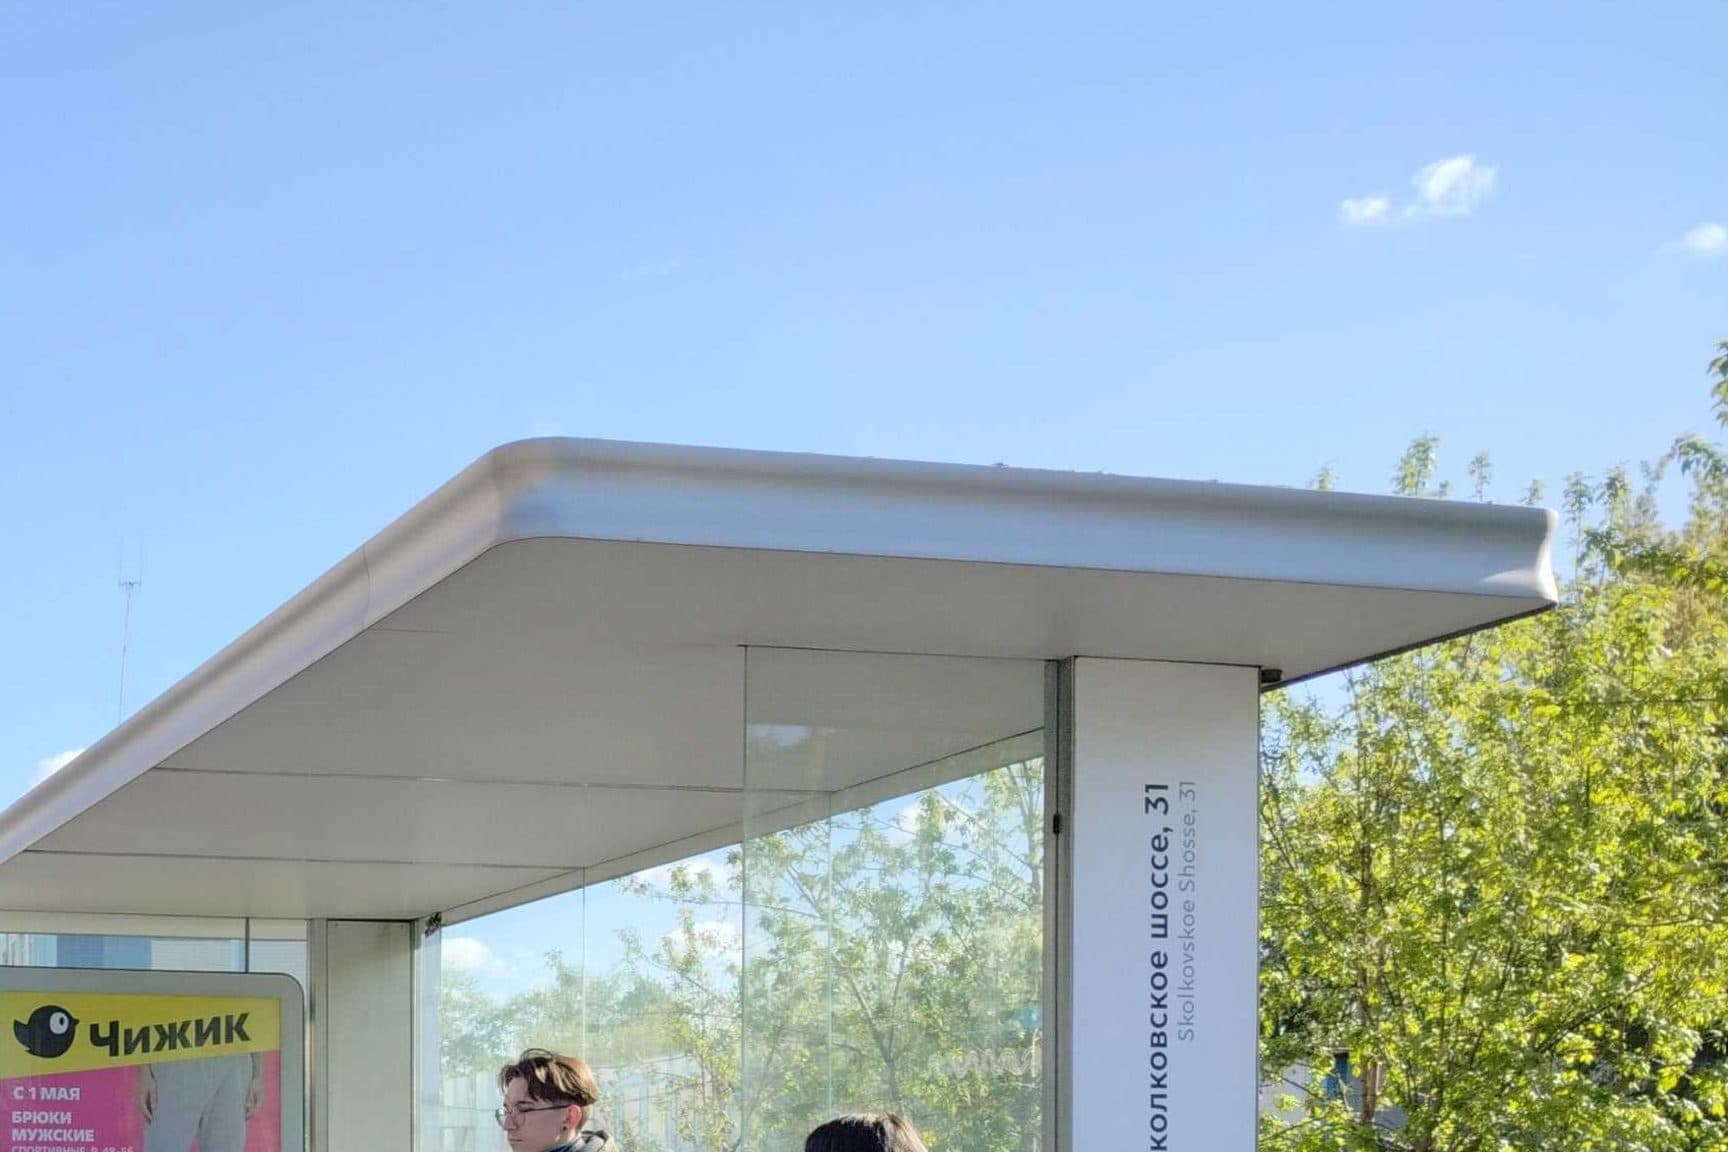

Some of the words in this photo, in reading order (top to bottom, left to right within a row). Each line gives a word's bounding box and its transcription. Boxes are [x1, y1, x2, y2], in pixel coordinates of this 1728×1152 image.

[1144, 783, 1169, 815] 31
[1178, 781, 1196, 801] 31
[1176, 809, 1199, 892] Shosse,
[1151, 826, 1174, 939] шоссе,
[1177, 899, 1195, 1041] Skolkovskoe
[13, 1086, 25, 1100] С
[28, 1086, 37, 1100] 1
[40, 1087, 81, 1101] МАЯ
[11, 1111, 72, 1125] БРЮКИ
[11, 1128, 95, 1142] МУЖСКИЕ
